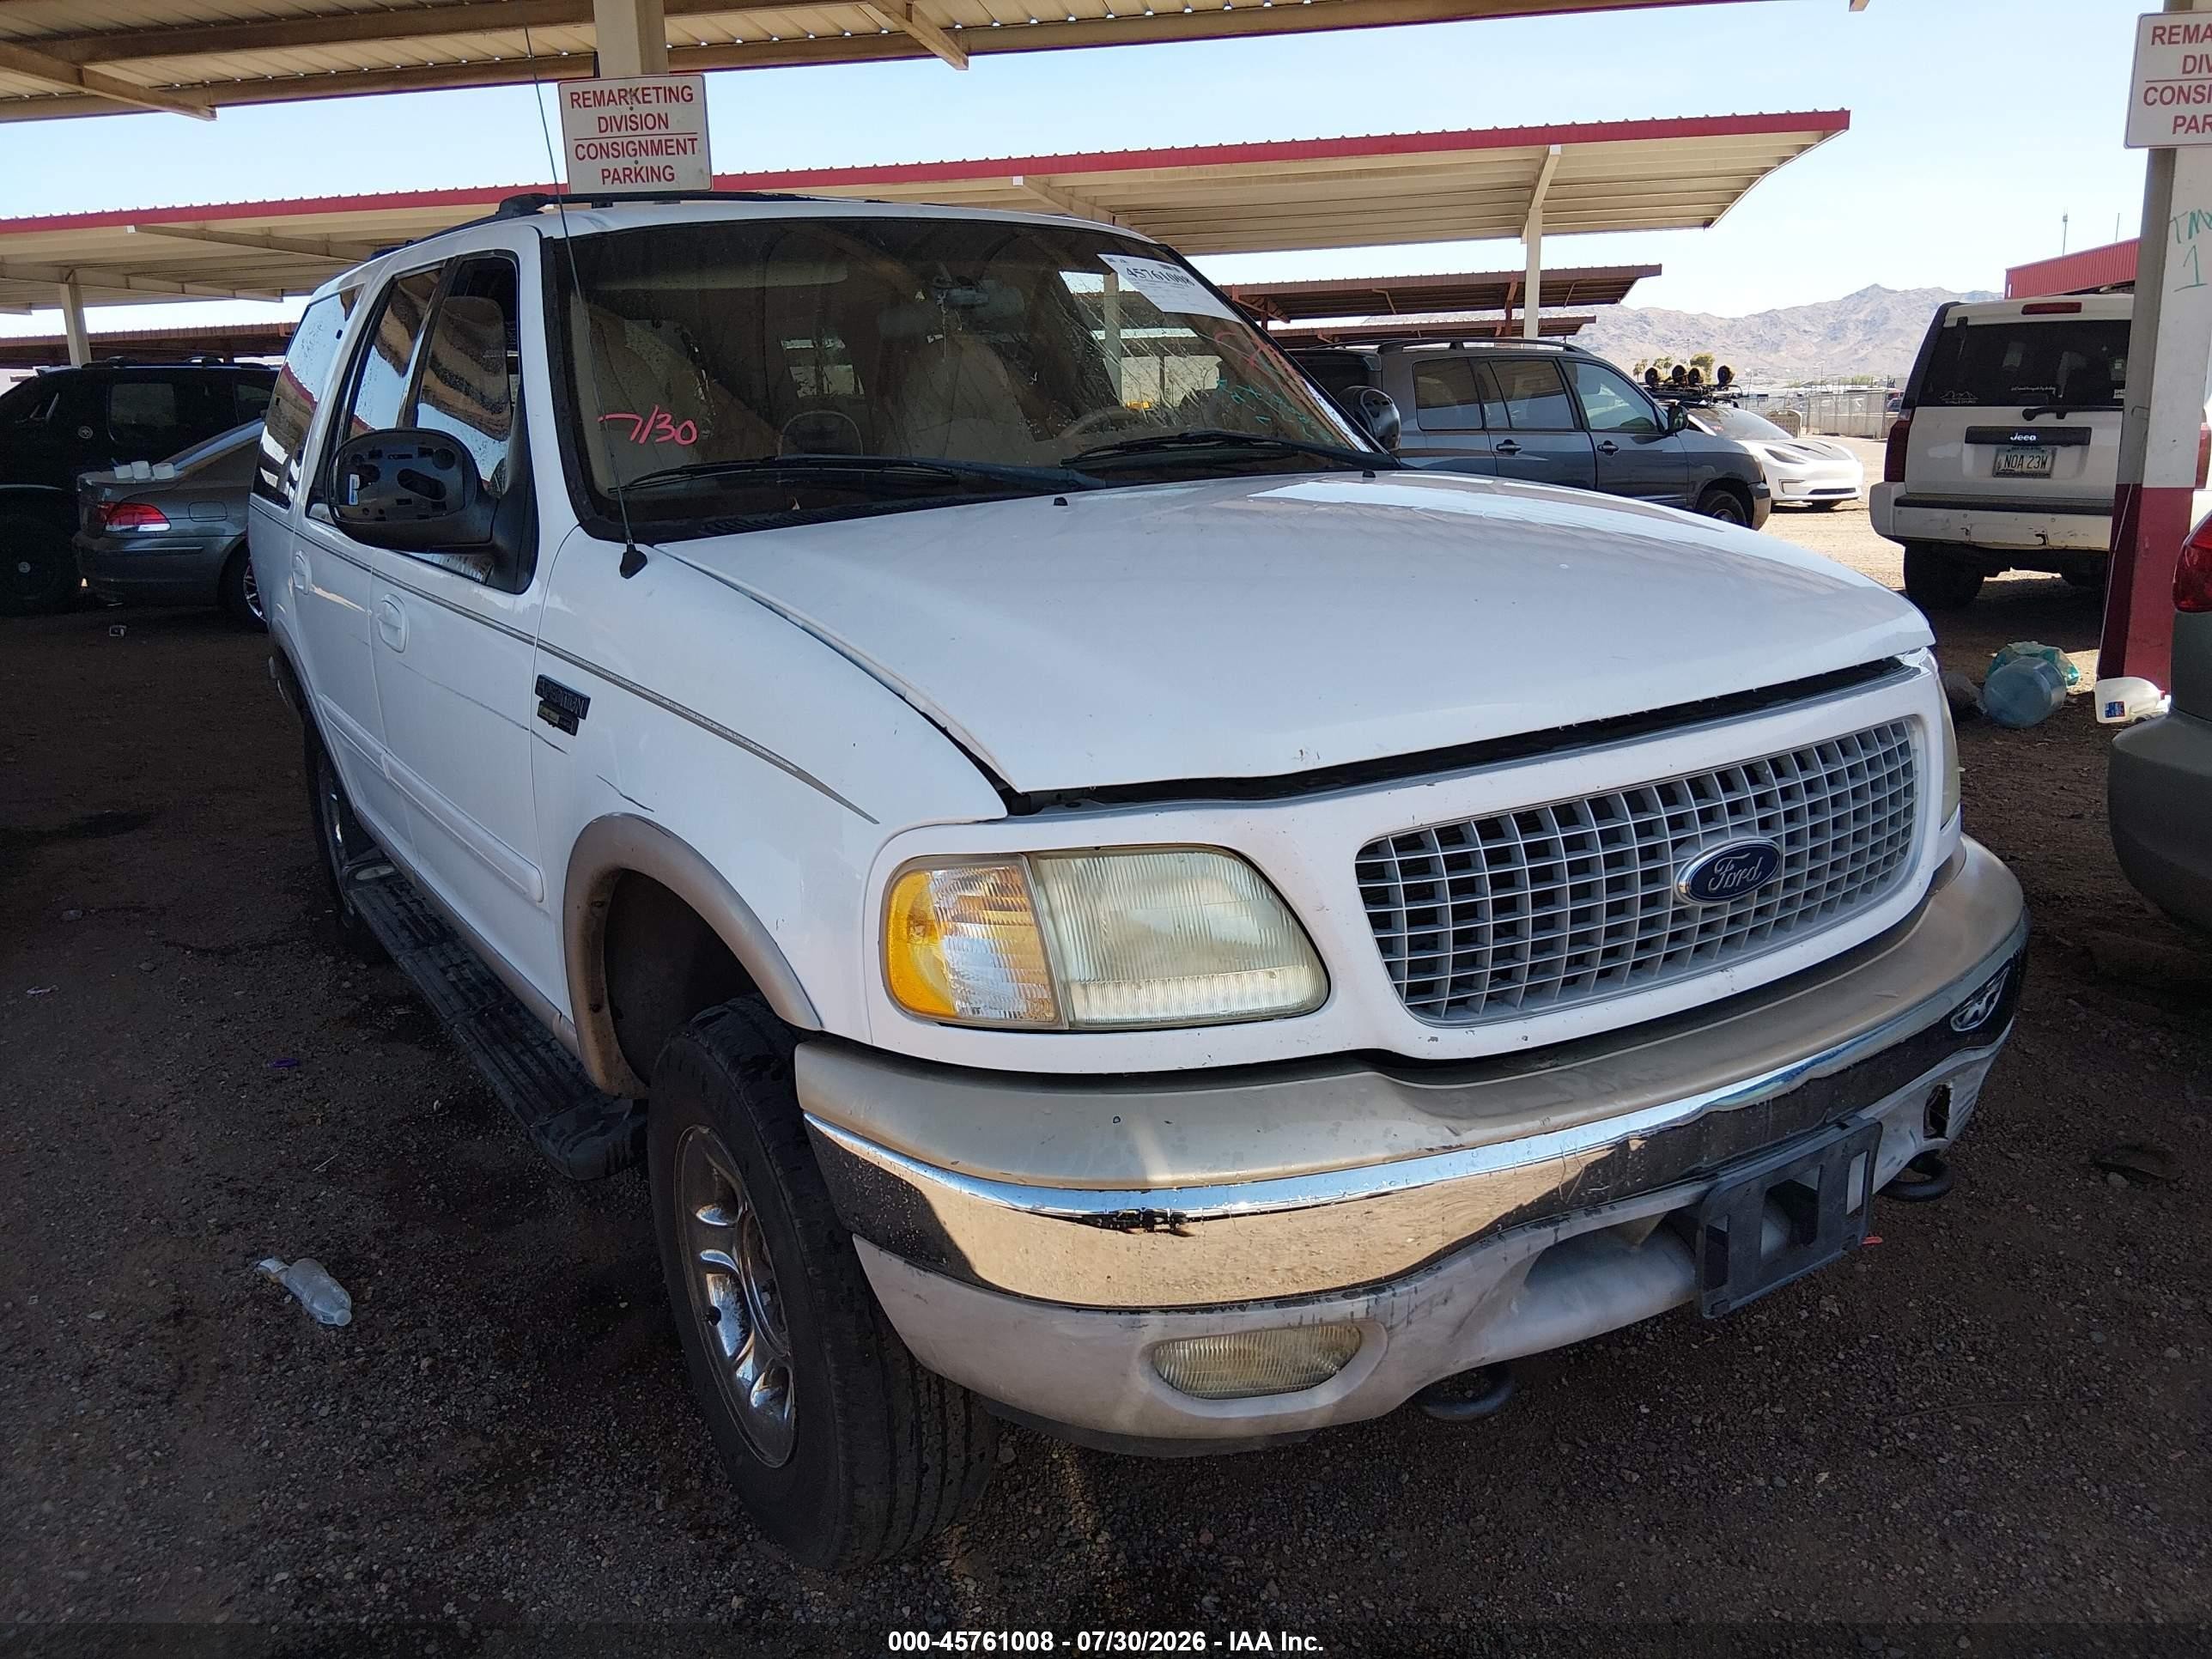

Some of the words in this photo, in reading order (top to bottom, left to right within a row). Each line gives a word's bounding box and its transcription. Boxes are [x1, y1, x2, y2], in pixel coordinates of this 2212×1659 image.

[570, 85, 694, 109] REMARKETING
[2144, 84, 2212, 106] CONSI
[598, 112, 669, 133] DIVISION
[574, 137, 697, 161] CONSIGNMENT
[601, 165, 675, 185] PARKING
[598, 404, 698, 446] 7/30
[1708, 853, 1764, 893] Ford
